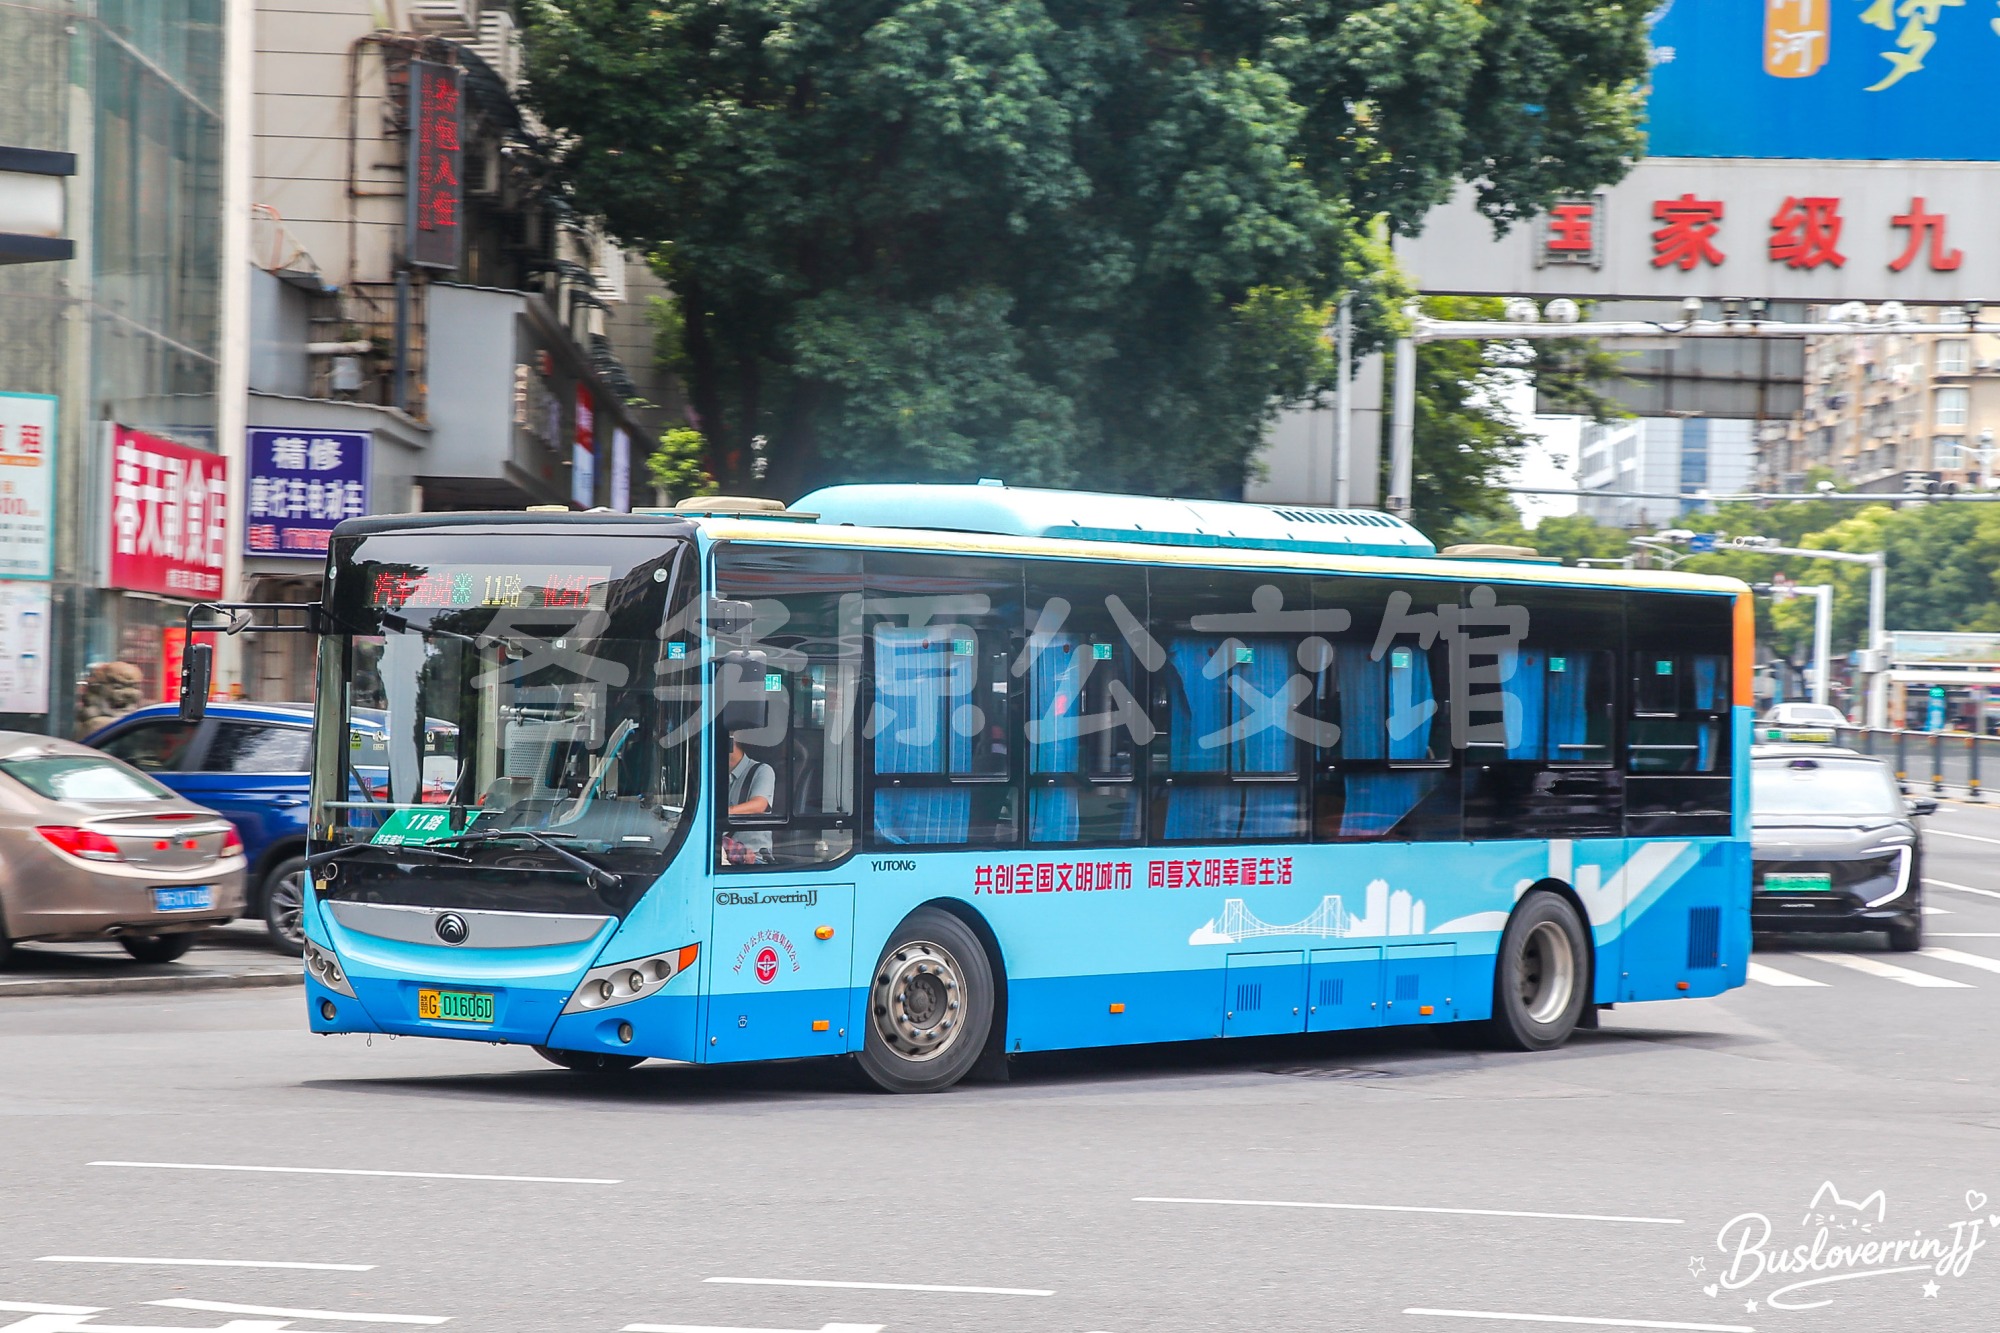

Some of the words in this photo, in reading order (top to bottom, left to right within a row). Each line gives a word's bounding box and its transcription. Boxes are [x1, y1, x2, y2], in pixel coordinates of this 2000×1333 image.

[374, 572, 453, 606] 汽车南站
[481, 574, 522, 608] 11路
[544, 574, 606, 608] 化纤厂
[406, 813, 446, 831] 11路
[871, 860, 917, 873] YUTONG
[974, 861, 1132, 895] 共创全国文明城市
[1147, 856, 1293, 890] 同享文明幸福生活
[732, 928, 801, 976] 九江市公共交通集团公司
